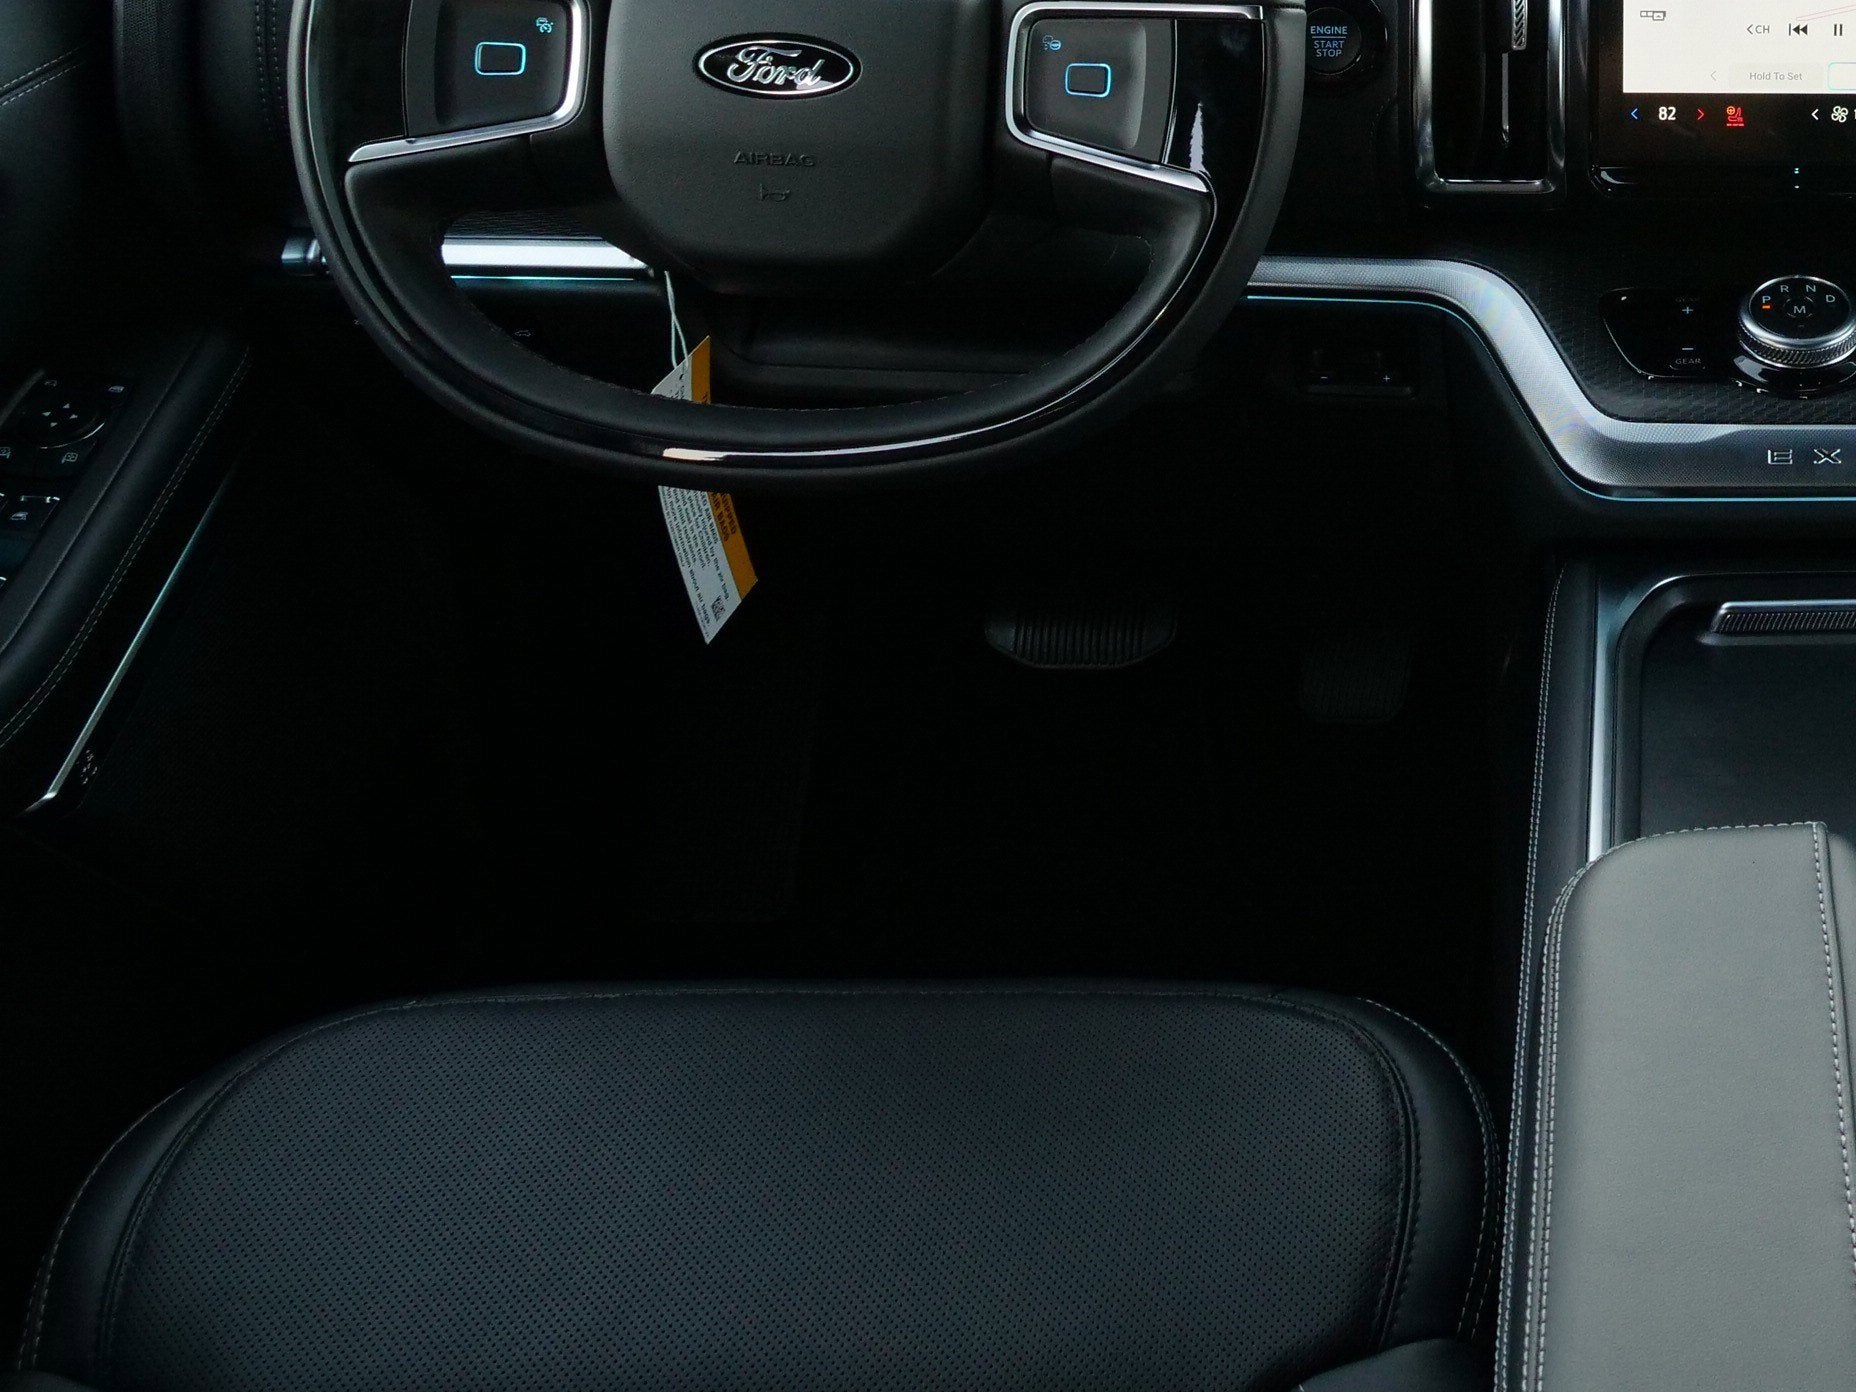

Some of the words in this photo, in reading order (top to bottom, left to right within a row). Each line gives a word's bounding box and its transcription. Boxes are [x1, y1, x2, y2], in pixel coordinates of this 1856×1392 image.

[1310, 26, 1347, 35] ENGINE
[1755, 24, 1770, 35] CH
[1313, 41, 1344, 49] START
[1316, 49, 1342, 57] STOP
[727, 46, 825, 87] Ford
[1749, 71, 1771, 81] Hold
[1774, 71, 1785, 81] To
[1787, 71, 1803, 81] Set
[1658, 107, 1676, 121] 82
[733, 151, 816, 166] AIRBAG
[1780, 285, 1790, 293] R
[1806, 284, 1816, 293] N
[1826, 295, 1836, 303] D
[1793, 306, 1806, 314] M
